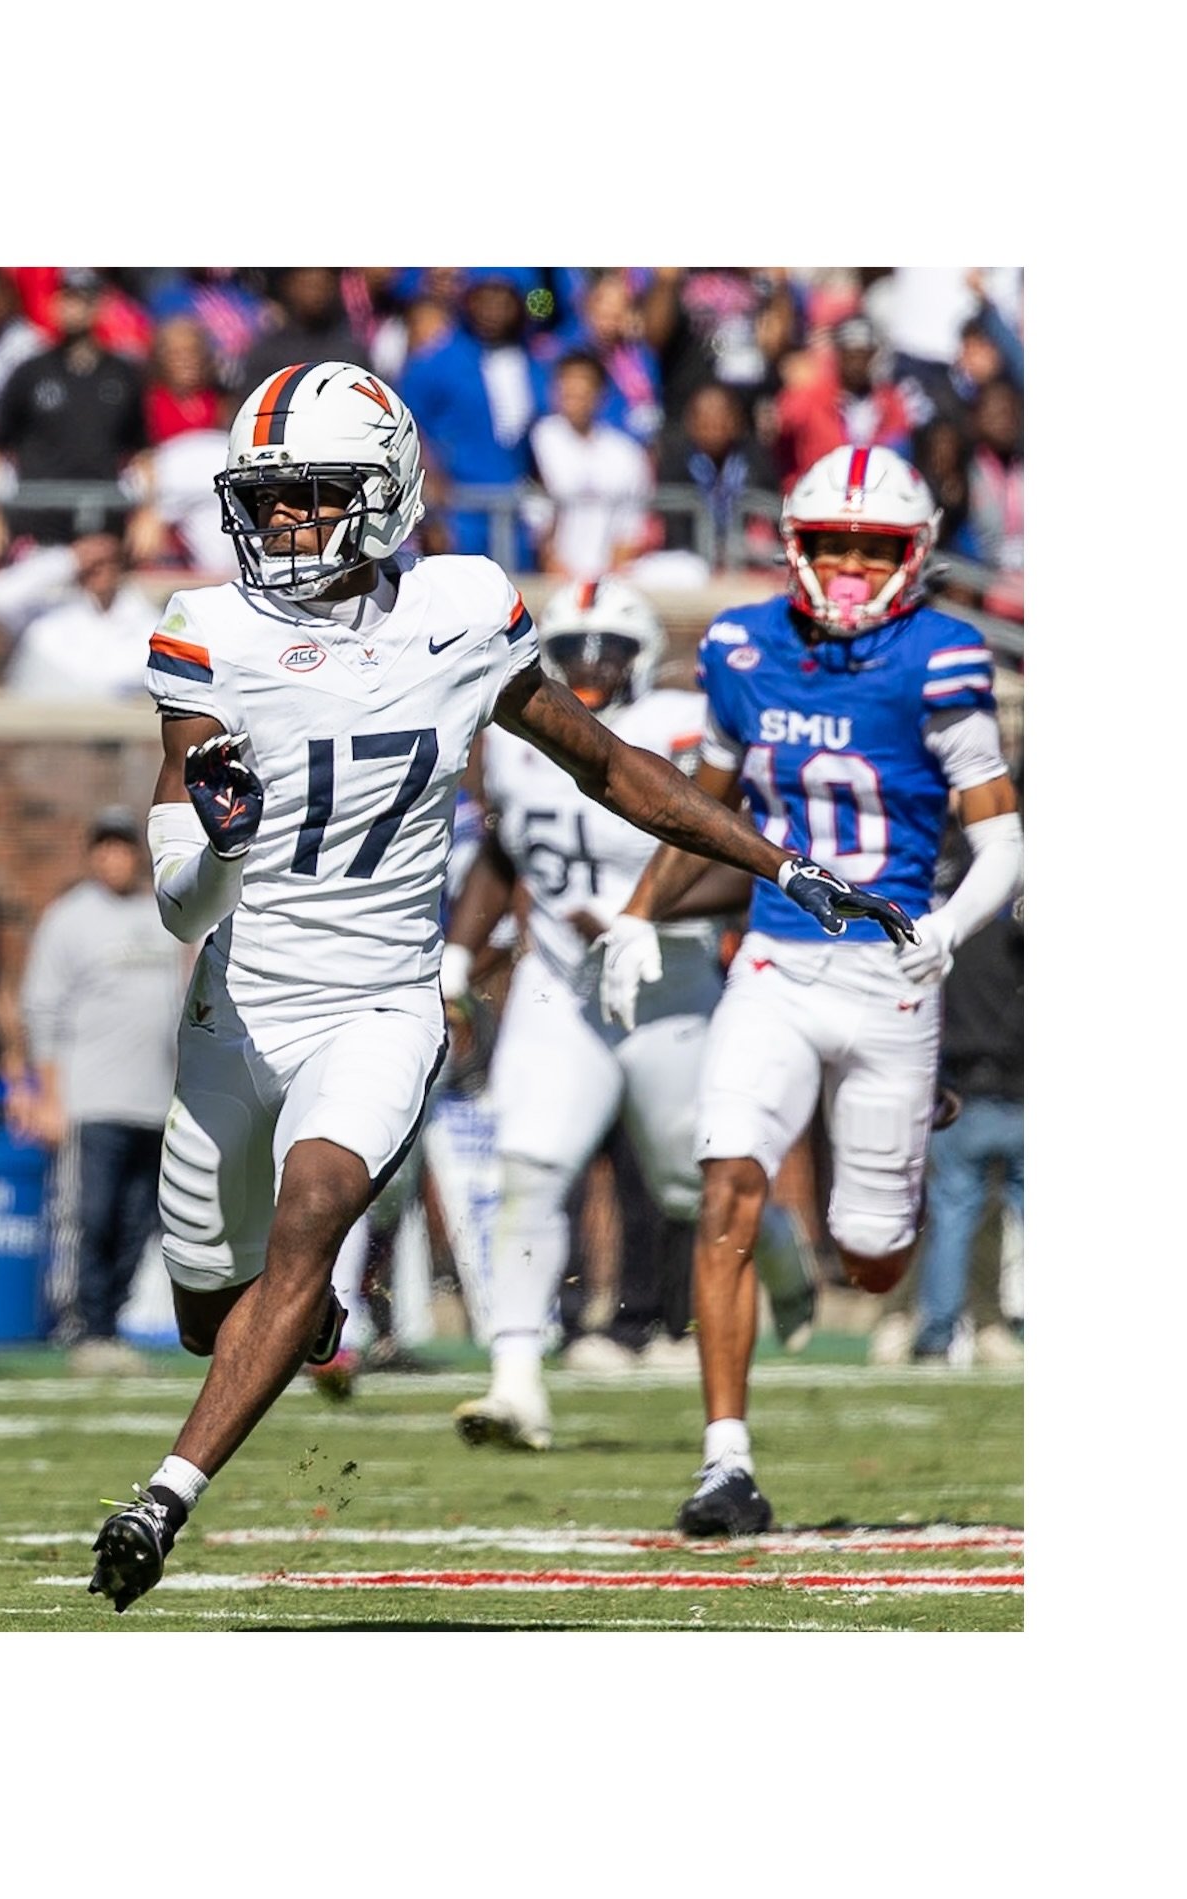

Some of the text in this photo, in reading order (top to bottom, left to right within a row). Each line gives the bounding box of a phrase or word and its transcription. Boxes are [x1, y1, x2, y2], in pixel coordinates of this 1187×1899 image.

[286, 650, 318, 666] ACC
[759, 708, 853, 750] SMU
[290, 727, 439, 879] 17
[742, 745, 890, 884] 10
